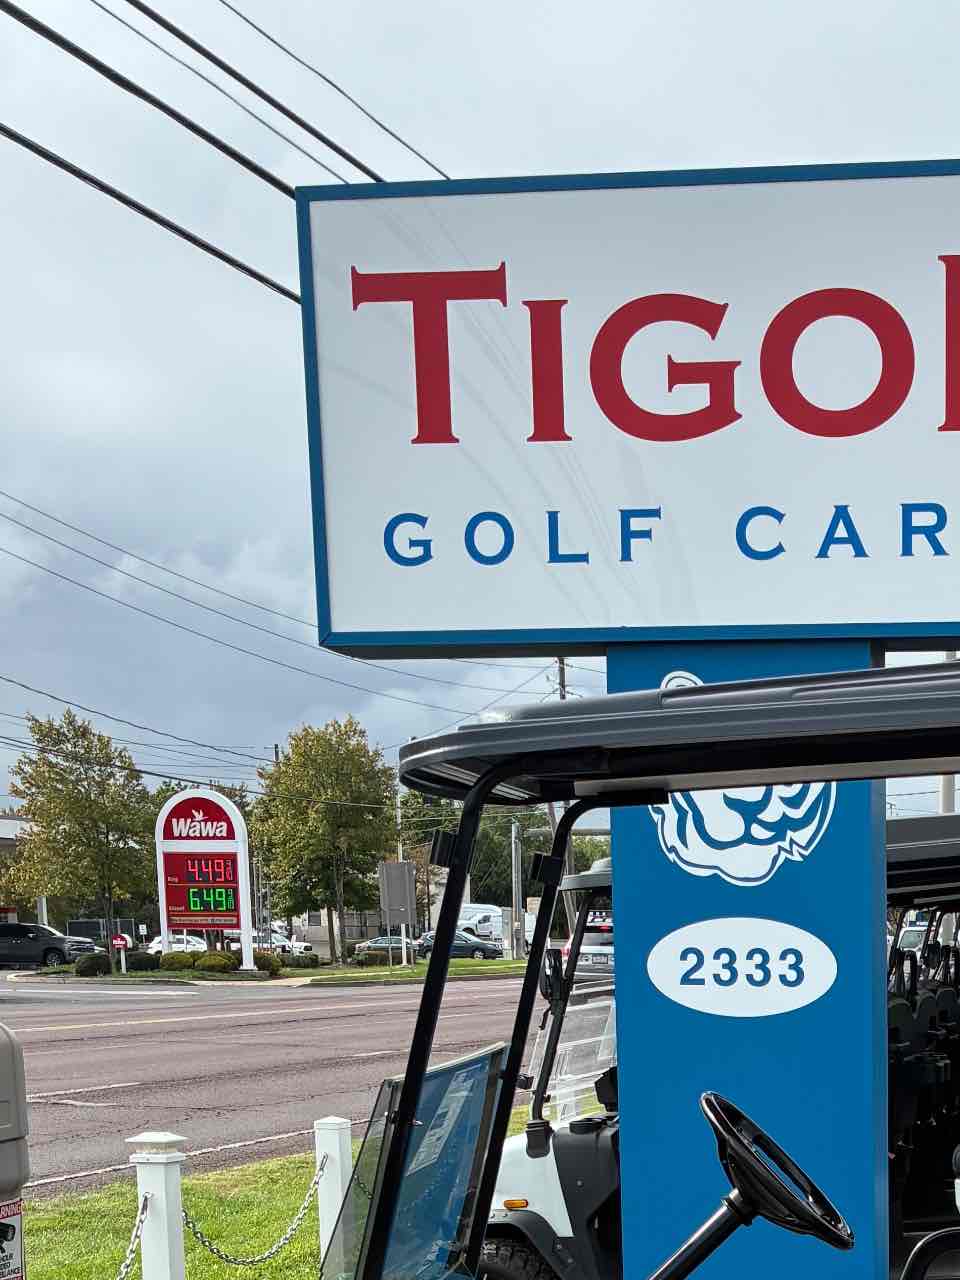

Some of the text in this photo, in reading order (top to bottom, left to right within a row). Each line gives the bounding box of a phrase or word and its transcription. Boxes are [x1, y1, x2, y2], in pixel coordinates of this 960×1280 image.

[383, 506, 662, 567] GOLF
[172, 818, 227, 837] Wawa
[680, 946, 805, 987] 2333
[0, 1202, 21, 1220] RNING
